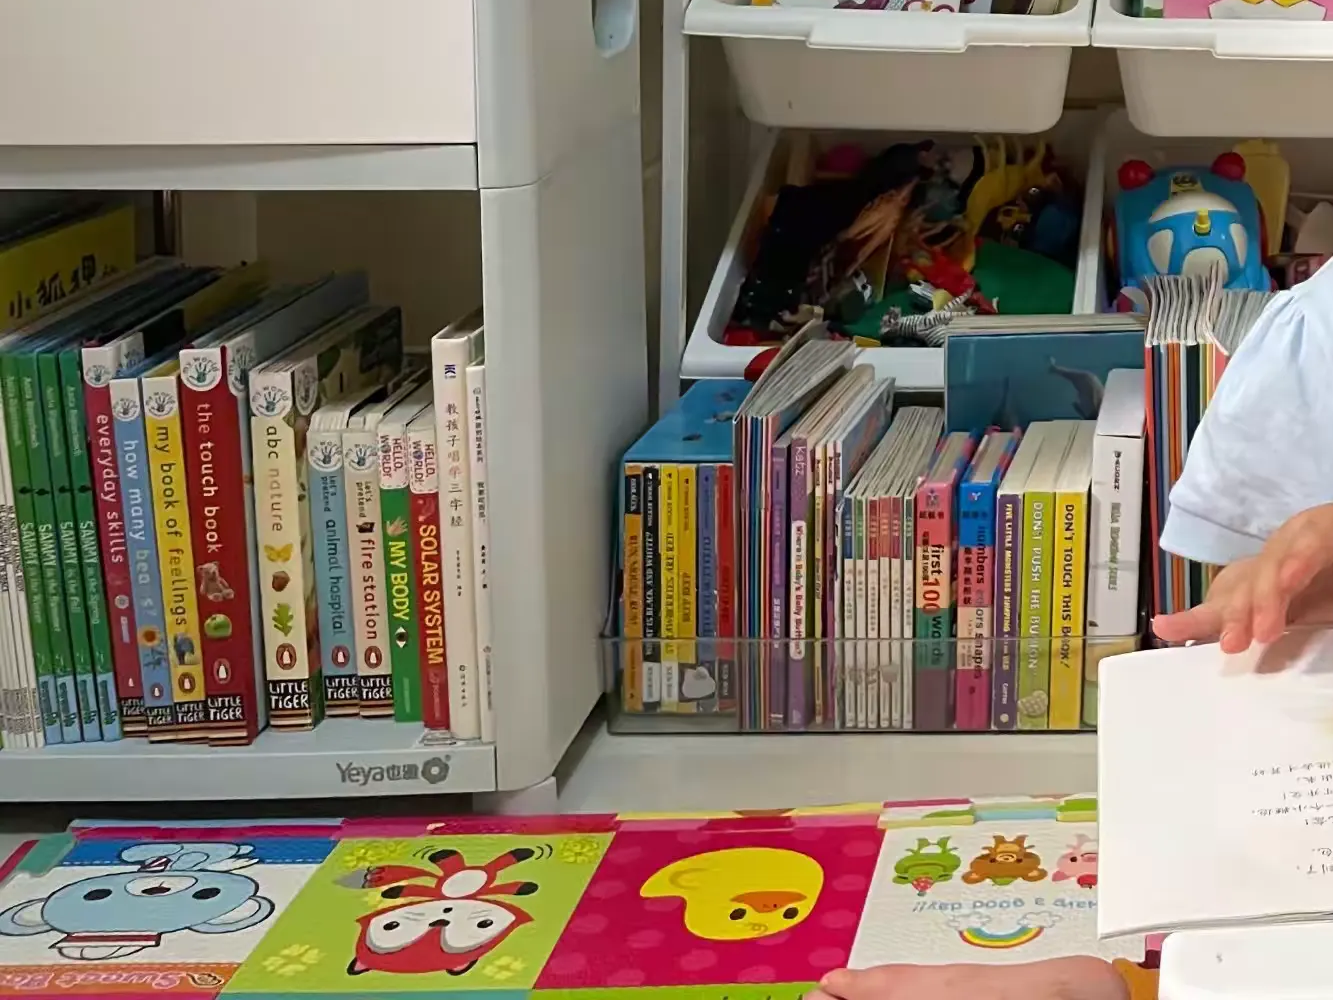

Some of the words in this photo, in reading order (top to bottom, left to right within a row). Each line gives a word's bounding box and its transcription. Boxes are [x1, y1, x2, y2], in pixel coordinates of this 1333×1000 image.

[195, 402, 213, 435] the
[154, 426, 174, 454] my
[265, 425, 283, 460] abc
[392, 438, 404, 472] HELLO,
[95, 414, 119, 503] everyday
[123, 440, 143, 479] how
[199, 442, 217, 497] touch
[422, 443, 434, 478] HELLO,
[160, 462, 180, 510] book
[268, 468, 287, 532] nature
[322, 476, 332, 512] pretend
[356, 482, 367, 518] pretend
[127, 488, 147, 542] many
[165, 518, 181, 538] of
[1004, 503, 1012, 519] FIVE
[1032, 502, 1043, 540] DON'T
[1063, 504, 1075, 542] DON'T
[19, 522, 37, 565] SAMMY
[38, 523, 56, 567] SAMMY
[59, 521, 78, 564] SAMMY
[79, 520, 98, 564] SAMMY
[106, 511, 125, 563] skills
[204, 506, 222, 554] book
[325, 519, 341, 573] animal
[795, 525, 804, 553] Where
[1004, 522, 1012, 547] LITTLE
[360, 539, 377, 571] fire
[389, 541, 406, 568] MY
[419, 525, 441, 585] SOLAR
[646, 531, 654, 567] WHITE?
[931, 544, 943, 576] first
[1031, 547, 1042, 581] PUSH
[646, 568, 654, 586] AND
[794, 564, 804, 592] Baby's
[1062, 547, 1073, 588] TOUCH
[168, 548, 189, 627] feelings
[391, 572, 410, 621] BODY
[646, 589, 654, 616] BLACK
[923, 578, 941, 614] 100
[327, 576, 347, 636] hospital
[362, 576, 379, 640] station
[1002, 596, 1011, 632] JUMPING
[1062, 594, 1072, 621] THIS
[423, 592, 445, 665] SYSTEM
[268, 680, 308, 696] LITTLE
[325, 676, 358, 689] LITTLE
[327, 686, 359, 700] TIGER
[360, 676, 392, 688] LITTLE
[361, 686, 392, 700] TIGER
[208, 696, 242, 708] LITTLE
[209, 707, 243, 721] TIGER
[269, 694, 310, 709] TIGER
[336, 762, 384, 786] Yeya
[971, 898, 1025, 910] good
